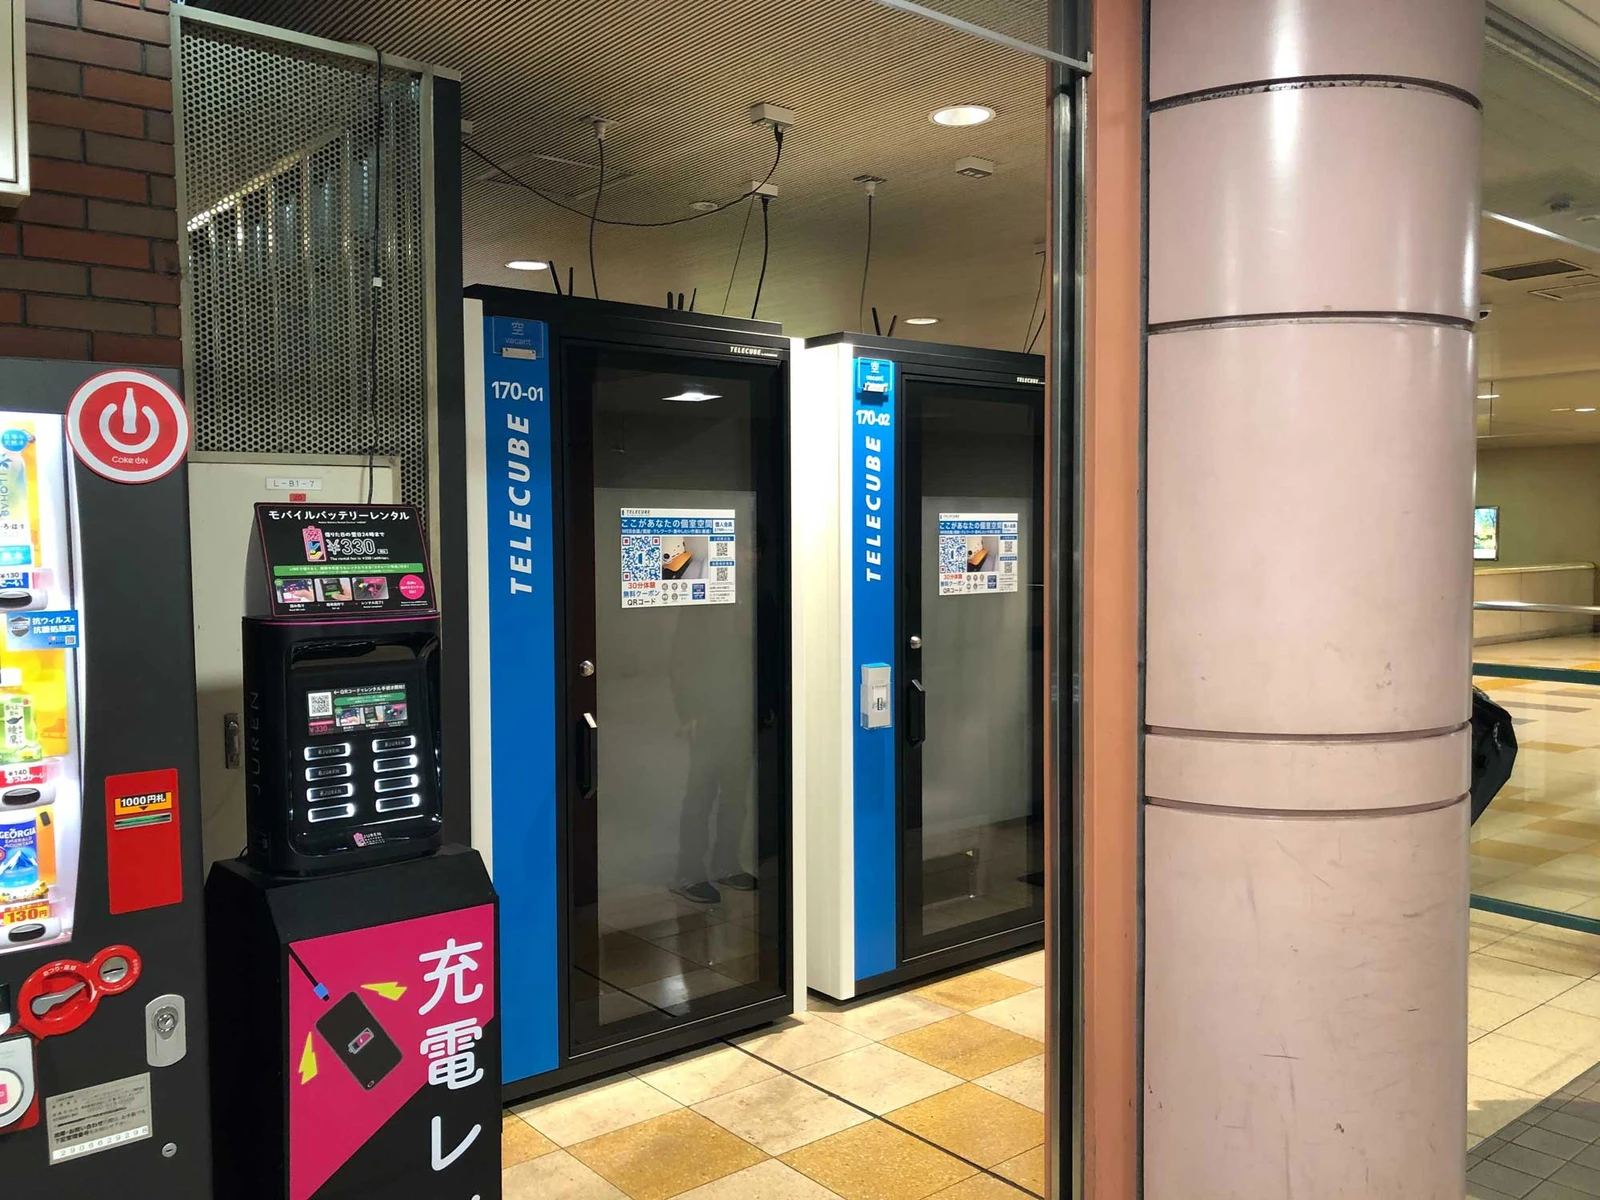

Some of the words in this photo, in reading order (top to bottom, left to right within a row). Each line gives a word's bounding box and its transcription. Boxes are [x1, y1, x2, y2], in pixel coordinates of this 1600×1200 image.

[730, 346, 761, 356] TELECUBE
[491, 381, 544, 402] 170-01
[856, 409, 891, 426] 170-02
[111, 455, 134, 465] Coke
[507, 413, 533, 595] TELECUBE
[865, 435, 882, 583] TELECUBE
[269, 510, 410, 521] モバイルバッテリーレンタル
[621, 519, 712, 528] ここがあなたの個室空間
[325, 538, 376, 556] ¥330
[623, 590, 660, 598] 無料クーポン
[627, 598, 656, 606] QRコード
[121, 795, 166, 807] 1000円札
[0, 827, 36, 839] GEORGIA
[7, 908, 48, 923] 130円
[418, 938, 484, 1200] 充電レ
